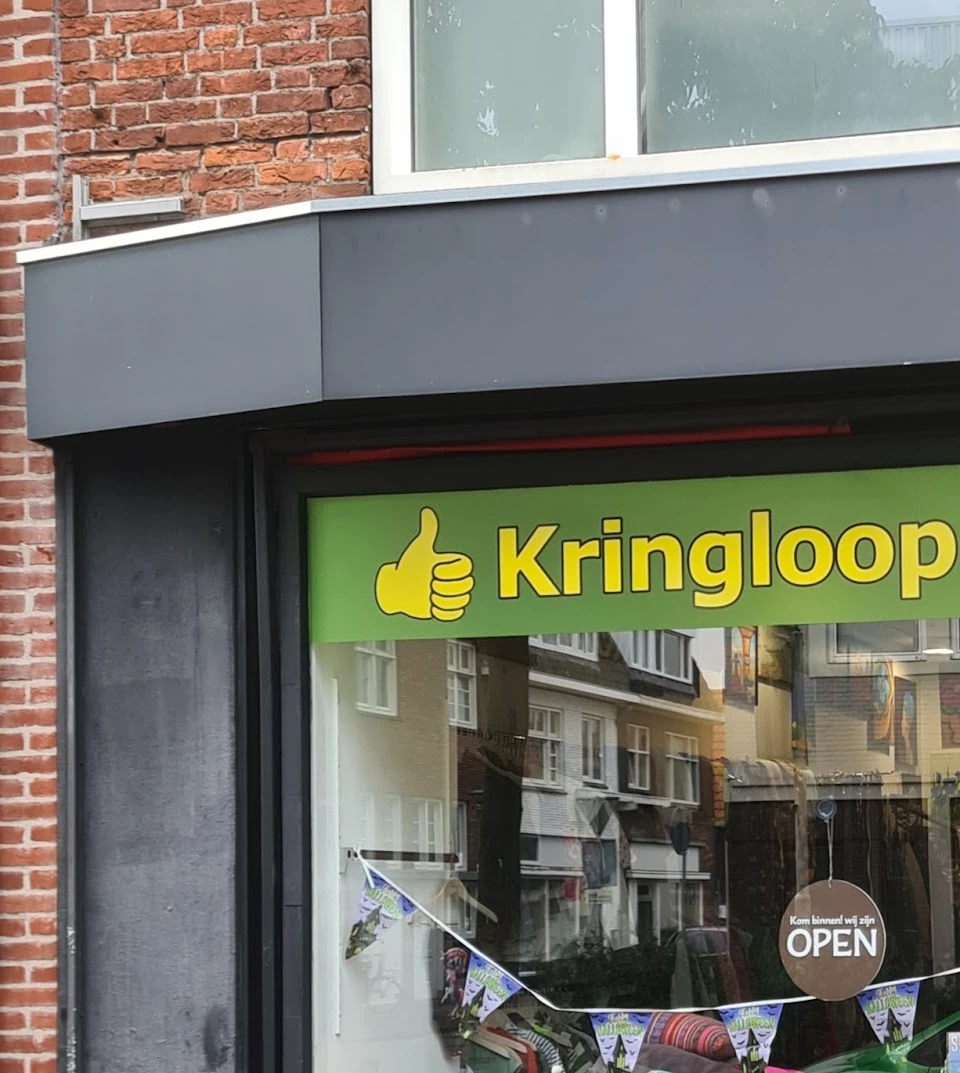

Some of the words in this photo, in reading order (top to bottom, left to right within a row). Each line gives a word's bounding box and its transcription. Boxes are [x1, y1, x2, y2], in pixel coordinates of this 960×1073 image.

[497, 508, 958, 609] Kringloop
[789, 915, 810, 926] Kom
[811, 914, 843, 925] binnen!
[844, 915, 858, 928] wij
[859, 915, 875, 927] zijn
[786, 928, 878, 958] OPEN
